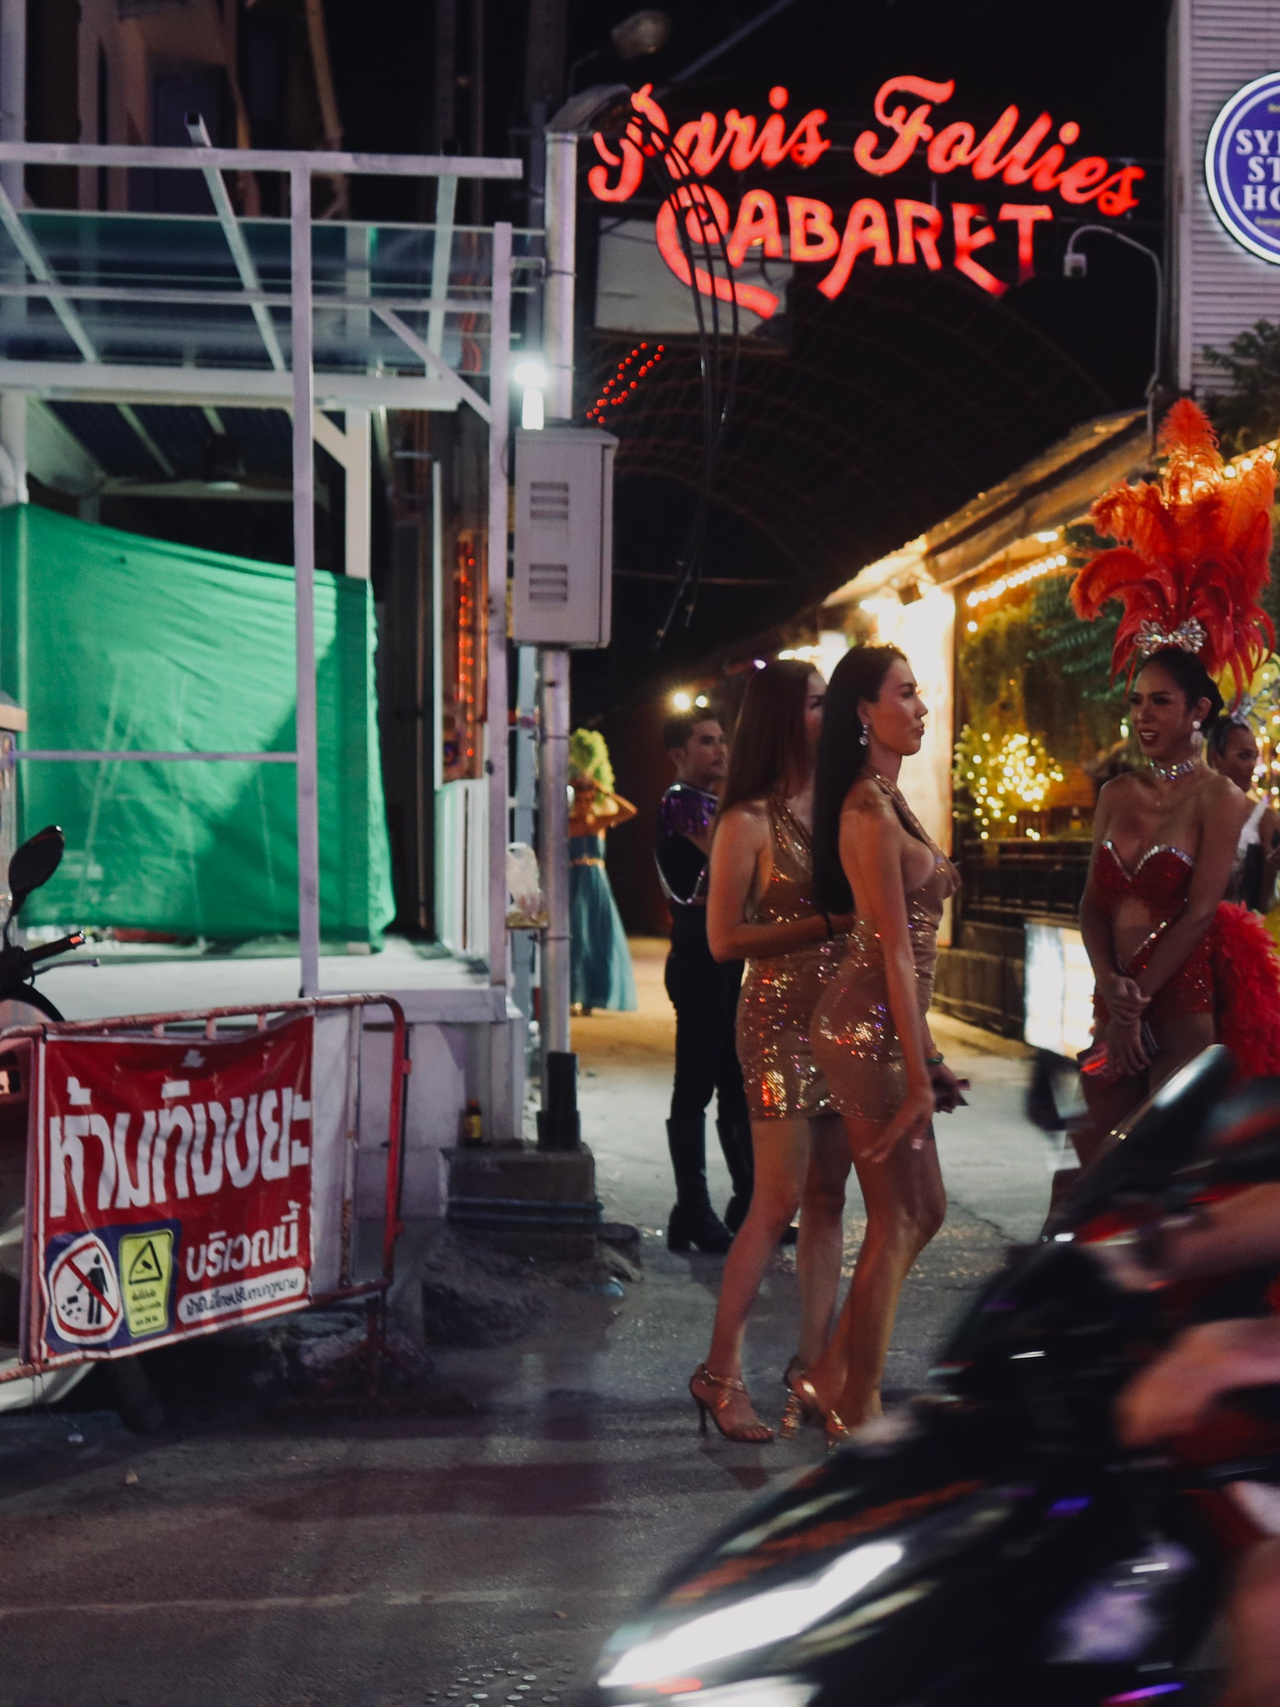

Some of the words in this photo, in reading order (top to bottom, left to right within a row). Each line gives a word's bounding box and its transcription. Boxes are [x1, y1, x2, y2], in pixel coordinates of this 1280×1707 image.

[588, 83, 831, 202] Paris
[854, 75, 1145, 216] Follies
[655, 184, 1053, 319] CABARET
